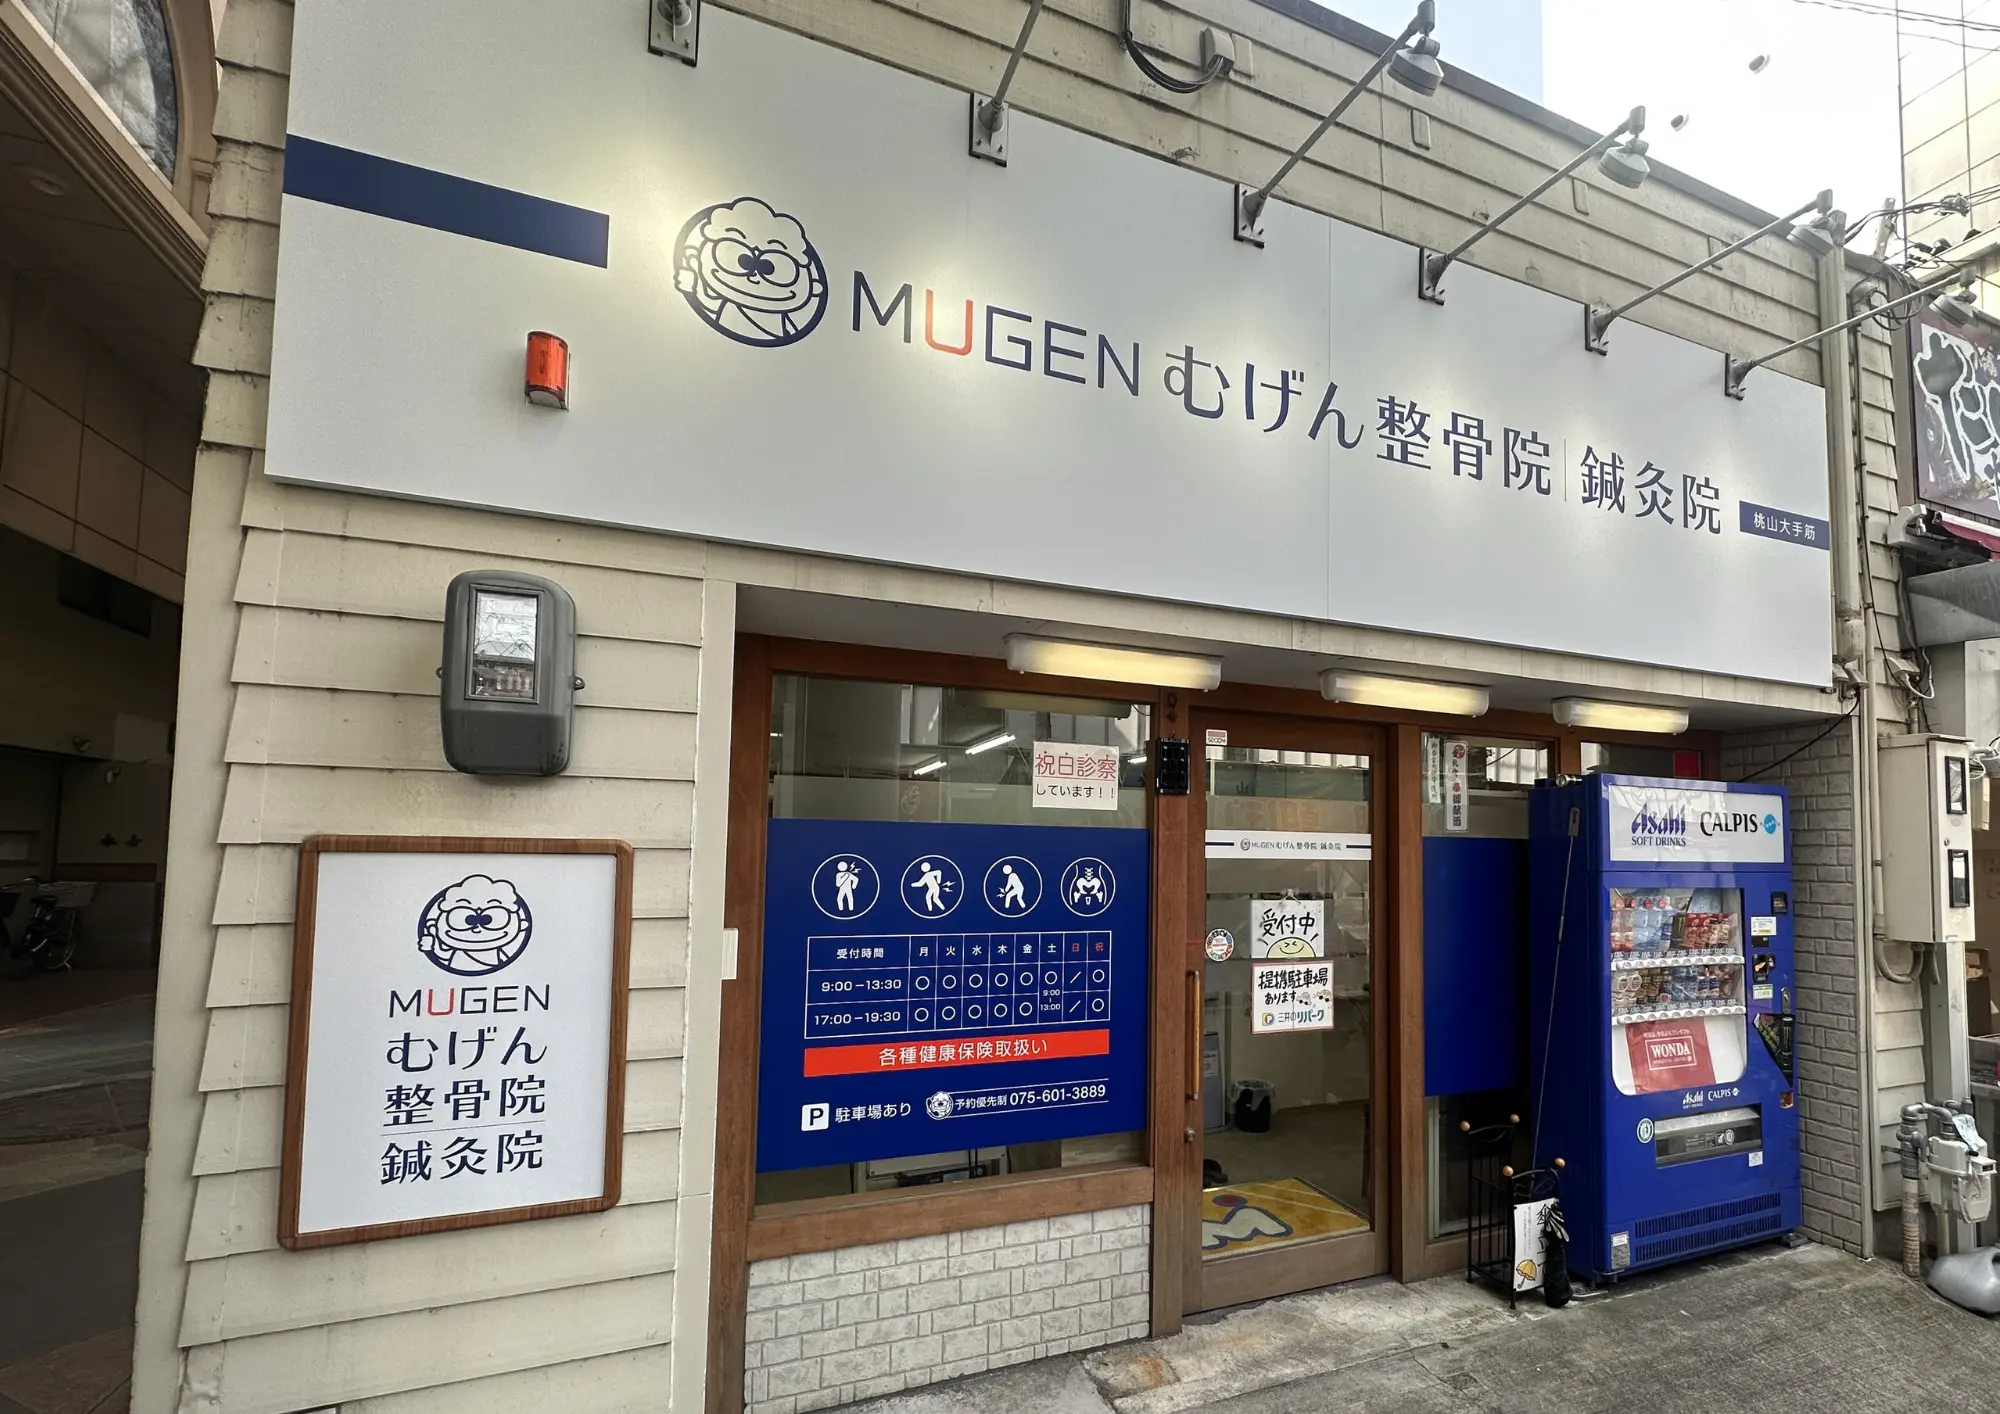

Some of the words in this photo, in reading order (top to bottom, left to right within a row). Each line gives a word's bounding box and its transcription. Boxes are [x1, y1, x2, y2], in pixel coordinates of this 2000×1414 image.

[852, 270, 1139, 397] MUGEN
[1163, 345, 1551, 496] むげん整骨院
[1580, 444, 1721, 535] 鍼灸院
[1753, 511, 1815, 541] 桃山大手筋
[1035, 753, 1117, 779] 祝日診察
[1631, 802, 1686, 835] Asahi
[1700, 811, 1758, 836] CALPIS
[1631, 836, 1653, 846] SOFT
[1655, 836, 1686, 847] DRINKS
[1260, 908, 1315, 937] 受付中
[836, 947, 884, 960] 受付時間
[919, 946, 929, 957] 月
[945, 945, 956, 956] 火
[971, 944, 982, 955] 水
[997, 943, 1008, 955] 木
[1022, 943, 1033, 954] 金
[1047, 943, 1057, 953] 土
[1072, 942, 1080, 952] 日
[1258, 967, 1328, 990] 提携駐車場
[388, 983, 550, 1018] MUGEN
[1264, 990, 1297, 1005] あります
[1278, 1009, 1325, 1024] 三井のリパーク
[386, 1025, 548, 1073] むげん
[878, 1038, 1048, 1067] 各種健康保険取扱い
[1650, 1041, 1691, 1059] WONDA
[383, 1073, 546, 1127] 整骨院
[809, 1107, 824, 1126] P
[835, 1101, 911, 1123] 駐車場あり
[955, 1094, 1007, 1110] 予約優先制
[1009, 1084, 1106, 1106] 075-601-3889
[1682, 1089, 1704, 1105] Asahi
[1707, 1088, 1732, 1101] CALPIS
[380, 1129, 544, 1185] 鍼灸院
